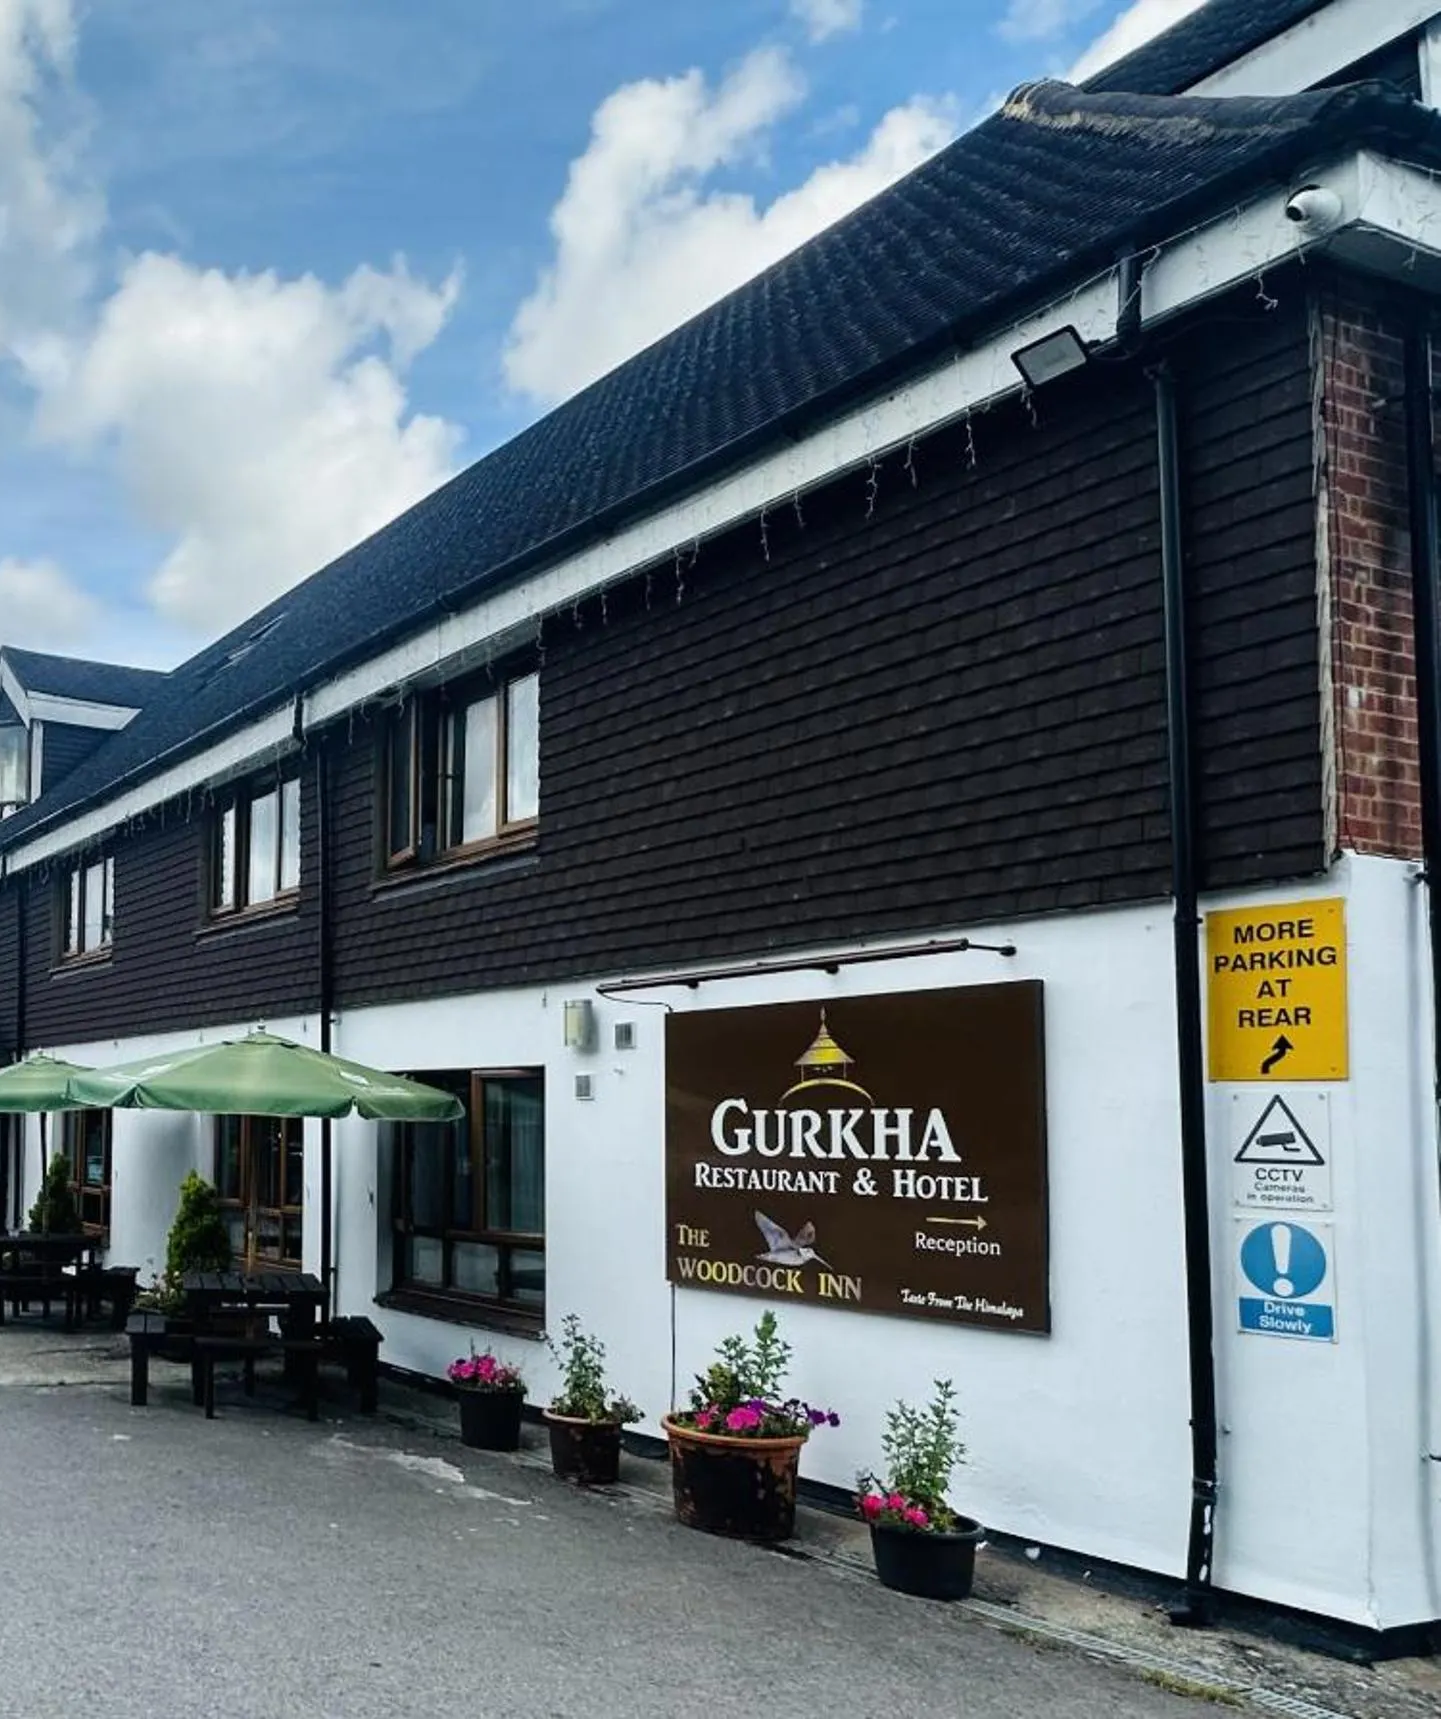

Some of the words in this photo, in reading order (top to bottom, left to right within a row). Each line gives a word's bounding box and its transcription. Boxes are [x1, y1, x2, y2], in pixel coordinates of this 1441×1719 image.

[1233, 918, 1316, 945] MORE
[1214, 945, 1337, 974] PARKING
[1256, 978, 1292, 999] AT
[1237, 1006, 1312, 1029] REAR
[710, 1098, 962, 1162] GURKHA
[695, 1162, 840, 1194] RESTAURANT
[852, 1168, 879, 1197] &
[893, 1169, 989, 1203] HOTEL
[1254, 1167, 1304, 1182] CCTV
[1254, 1183, 1305, 1193] Cameras
[1260, 1193, 1314, 1204] operation
[676, 1224, 711, 1248] THE
[916, 1232, 1001, 1257] Reception
[676, 1257, 804, 1294] WOODCOCK
[819, 1272, 862, 1301] INN
[901, 1288, 926, 1305] Taste
[927, 1292, 953, 1308] From
[954, 1296, 973, 1311] The
[975, 1298, 1024, 1319] Himalaya
[1263, 1301, 1305, 1316] Drive
[1259, 1315, 1312, 1334] Slowly
